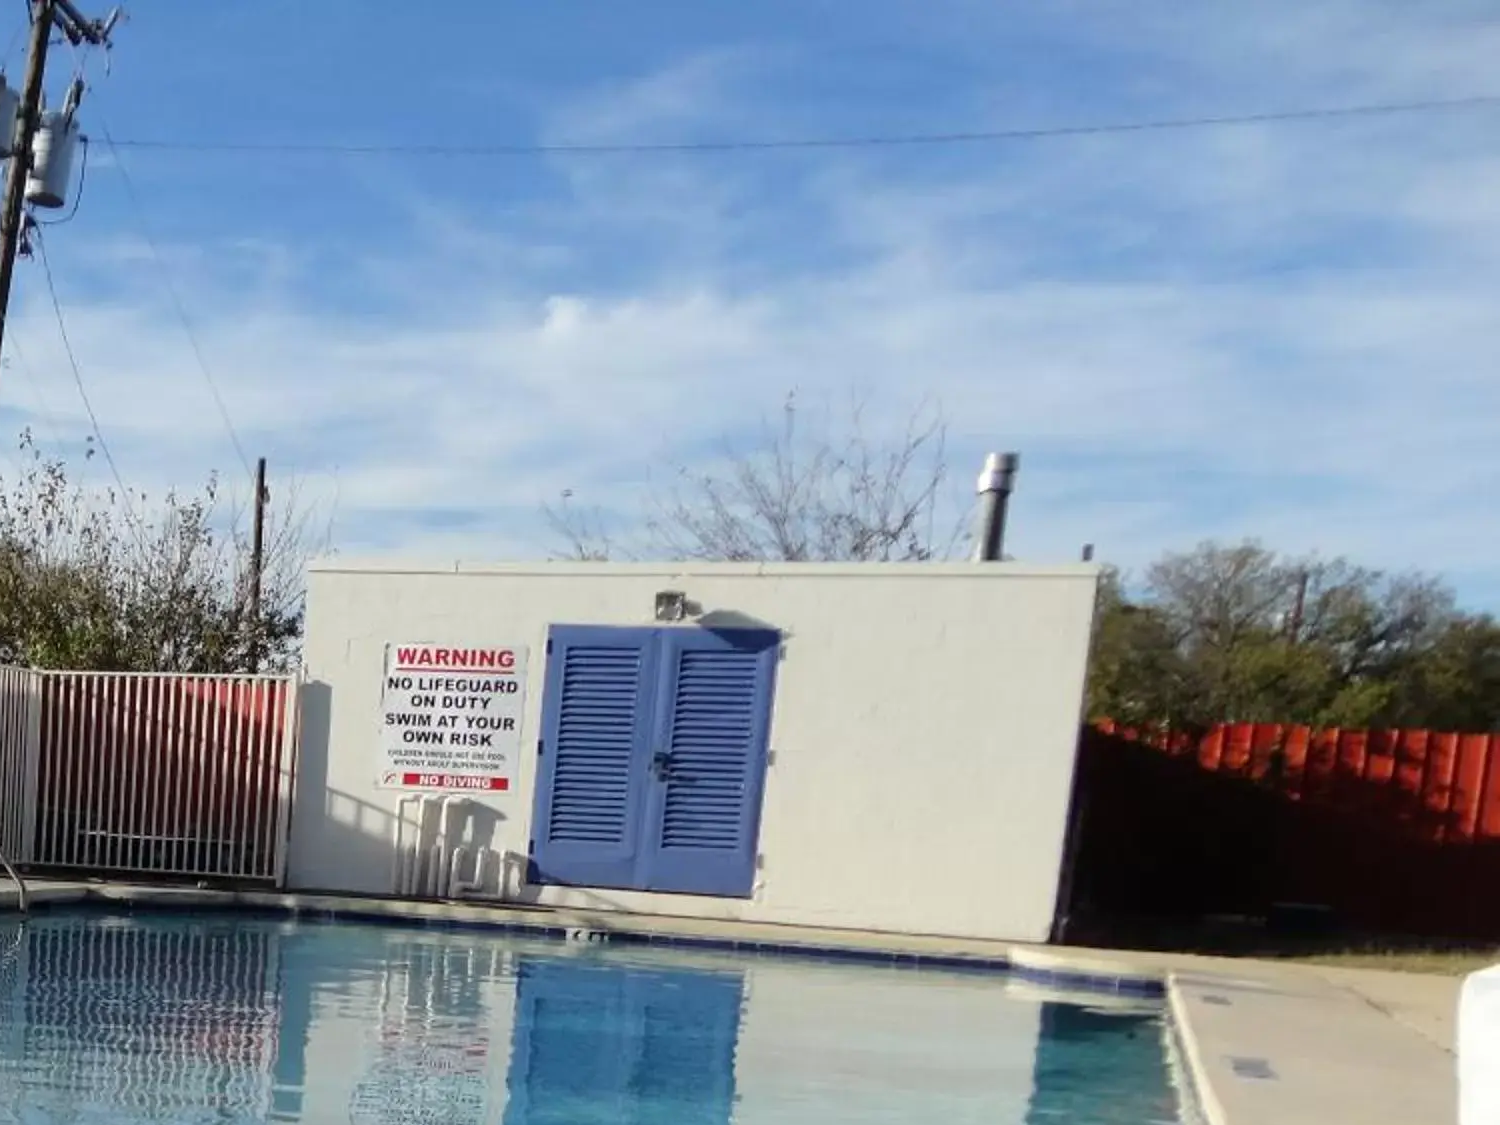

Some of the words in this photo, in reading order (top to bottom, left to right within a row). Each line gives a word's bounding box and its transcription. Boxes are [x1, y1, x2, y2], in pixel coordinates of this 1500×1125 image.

[397, 648, 515, 667] WARNING
[387, 677, 412, 690] NO
[419, 677, 518, 693] LIFEGUARD
[411, 695, 435, 708] ON
[442, 695, 492, 710] DUTY
[385, 713, 431, 726] SWIM
[437, 715, 458, 728] AT
[465, 716, 515, 731] YOUR
[403, 730, 443, 745] OWN
[450, 733, 493, 747] RISK
[419, 774, 439, 785] NO
[443, 775, 491, 788] DIVING
